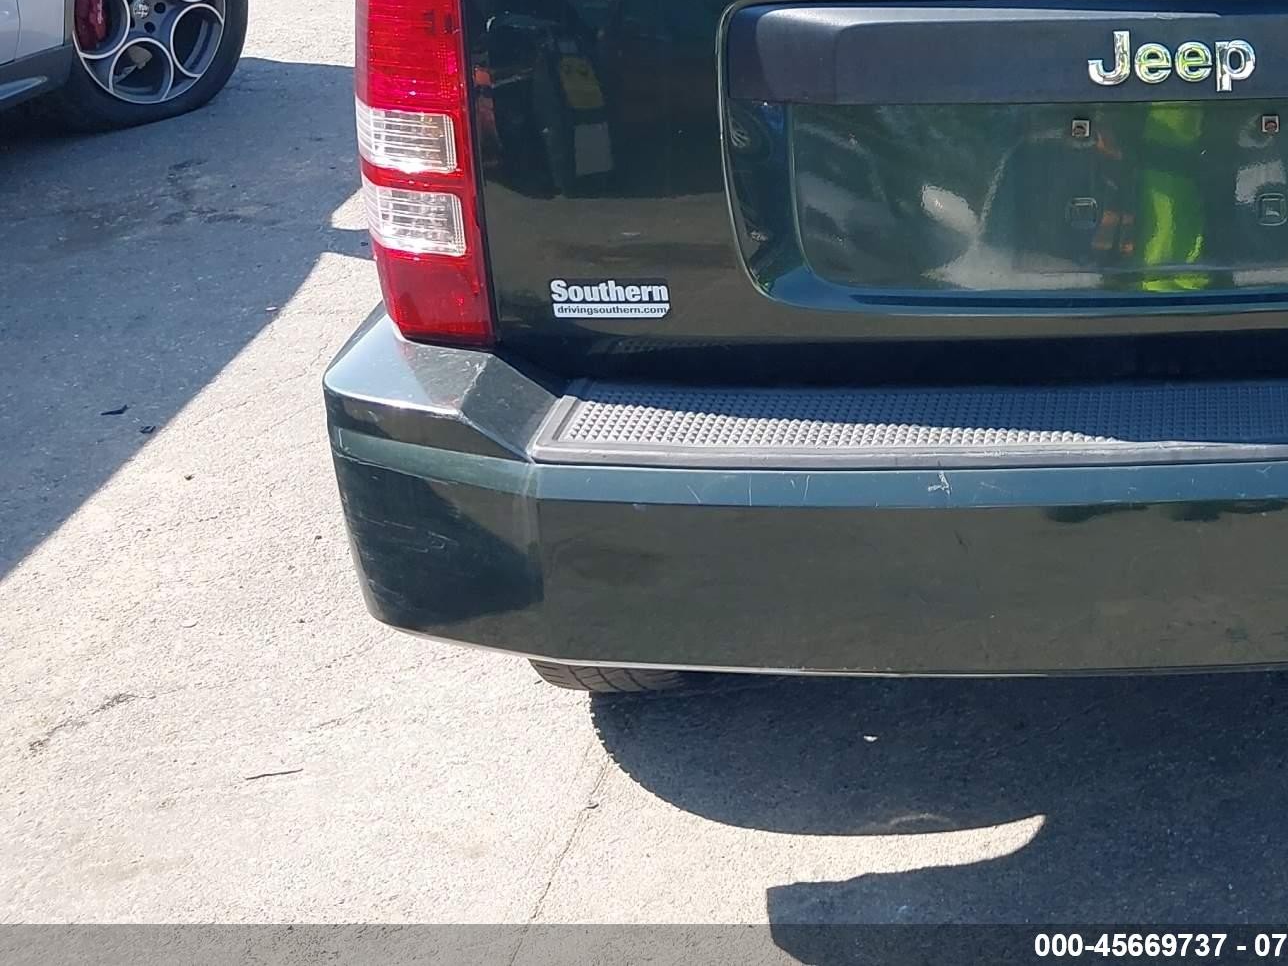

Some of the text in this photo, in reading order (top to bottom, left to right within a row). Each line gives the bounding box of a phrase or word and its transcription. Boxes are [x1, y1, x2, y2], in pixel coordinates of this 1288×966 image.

[1088, 30, 1256, 92] Jeep
[550, 279, 669, 302] Southern
[557, 305, 667, 315] drivingsouthern.com
